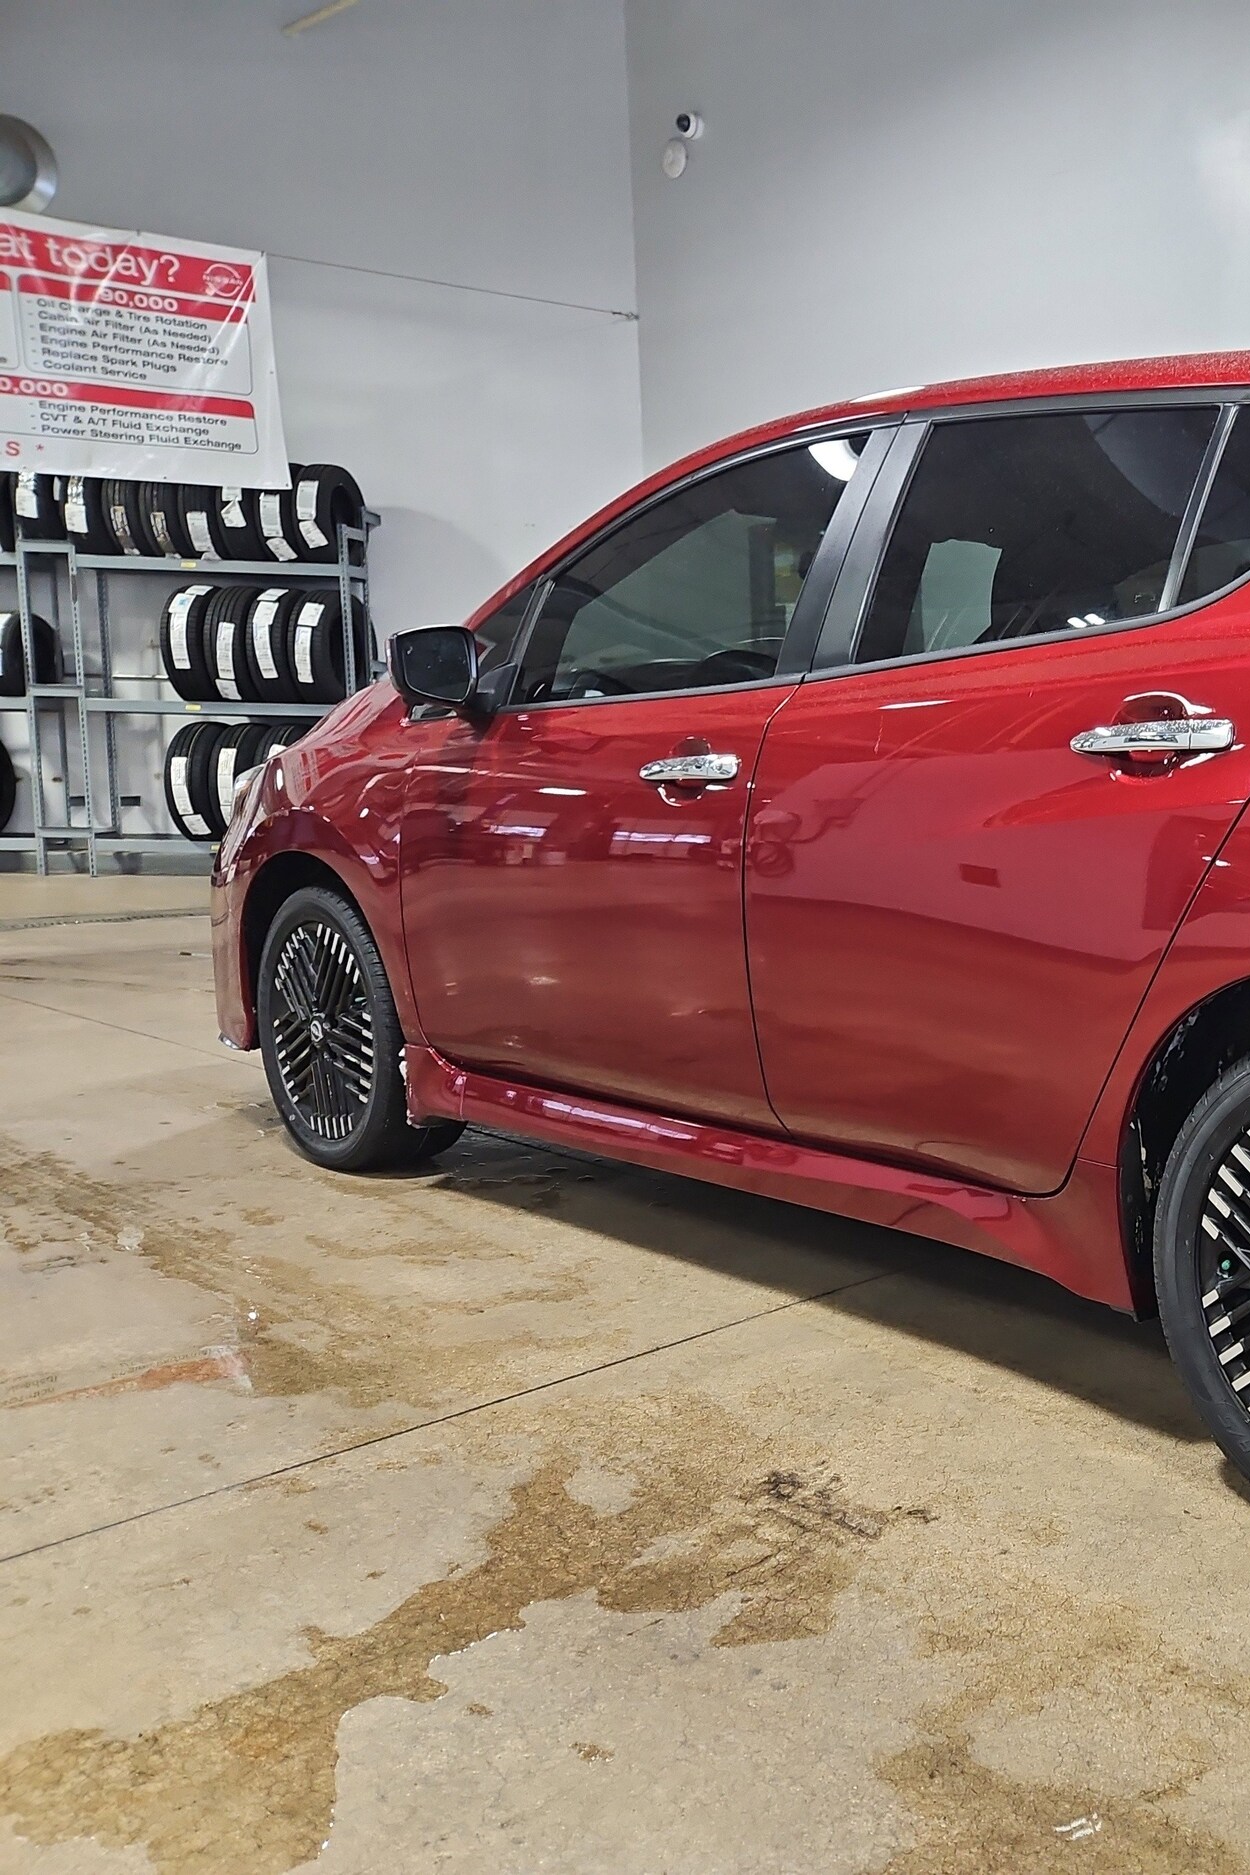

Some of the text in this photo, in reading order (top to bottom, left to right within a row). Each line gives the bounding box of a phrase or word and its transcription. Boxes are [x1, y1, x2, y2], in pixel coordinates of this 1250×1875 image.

[45, 238, 180, 286] today?
[37, 298, 55, 308] Oil
[115, 310, 124, 319] &
[128, 311, 150, 322] Tire
[155, 315, 208, 329] Rotation
[38, 310, 79, 323] Cabin
[105, 319, 135, 332] Filter
[140, 325, 158, 336] (As
[163, 328, 212, 344] Needed)
[39, 322, 220, 356] Engine Air Filter (As Needed)
[40, 335, 88, 348] Engine
[92, 341, 174, 360] Performance
[41, 347, 177, 373] Replace Spark Plugs
[43, 359, 147, 380] Coolant Service
[39, 400, 227, 426] Engine Performance Restore
[40, 412, 210, 437] CVT & A/T Fluid Exchange
[41, 424, 242, 452] Power Steering Fluid Exchange
